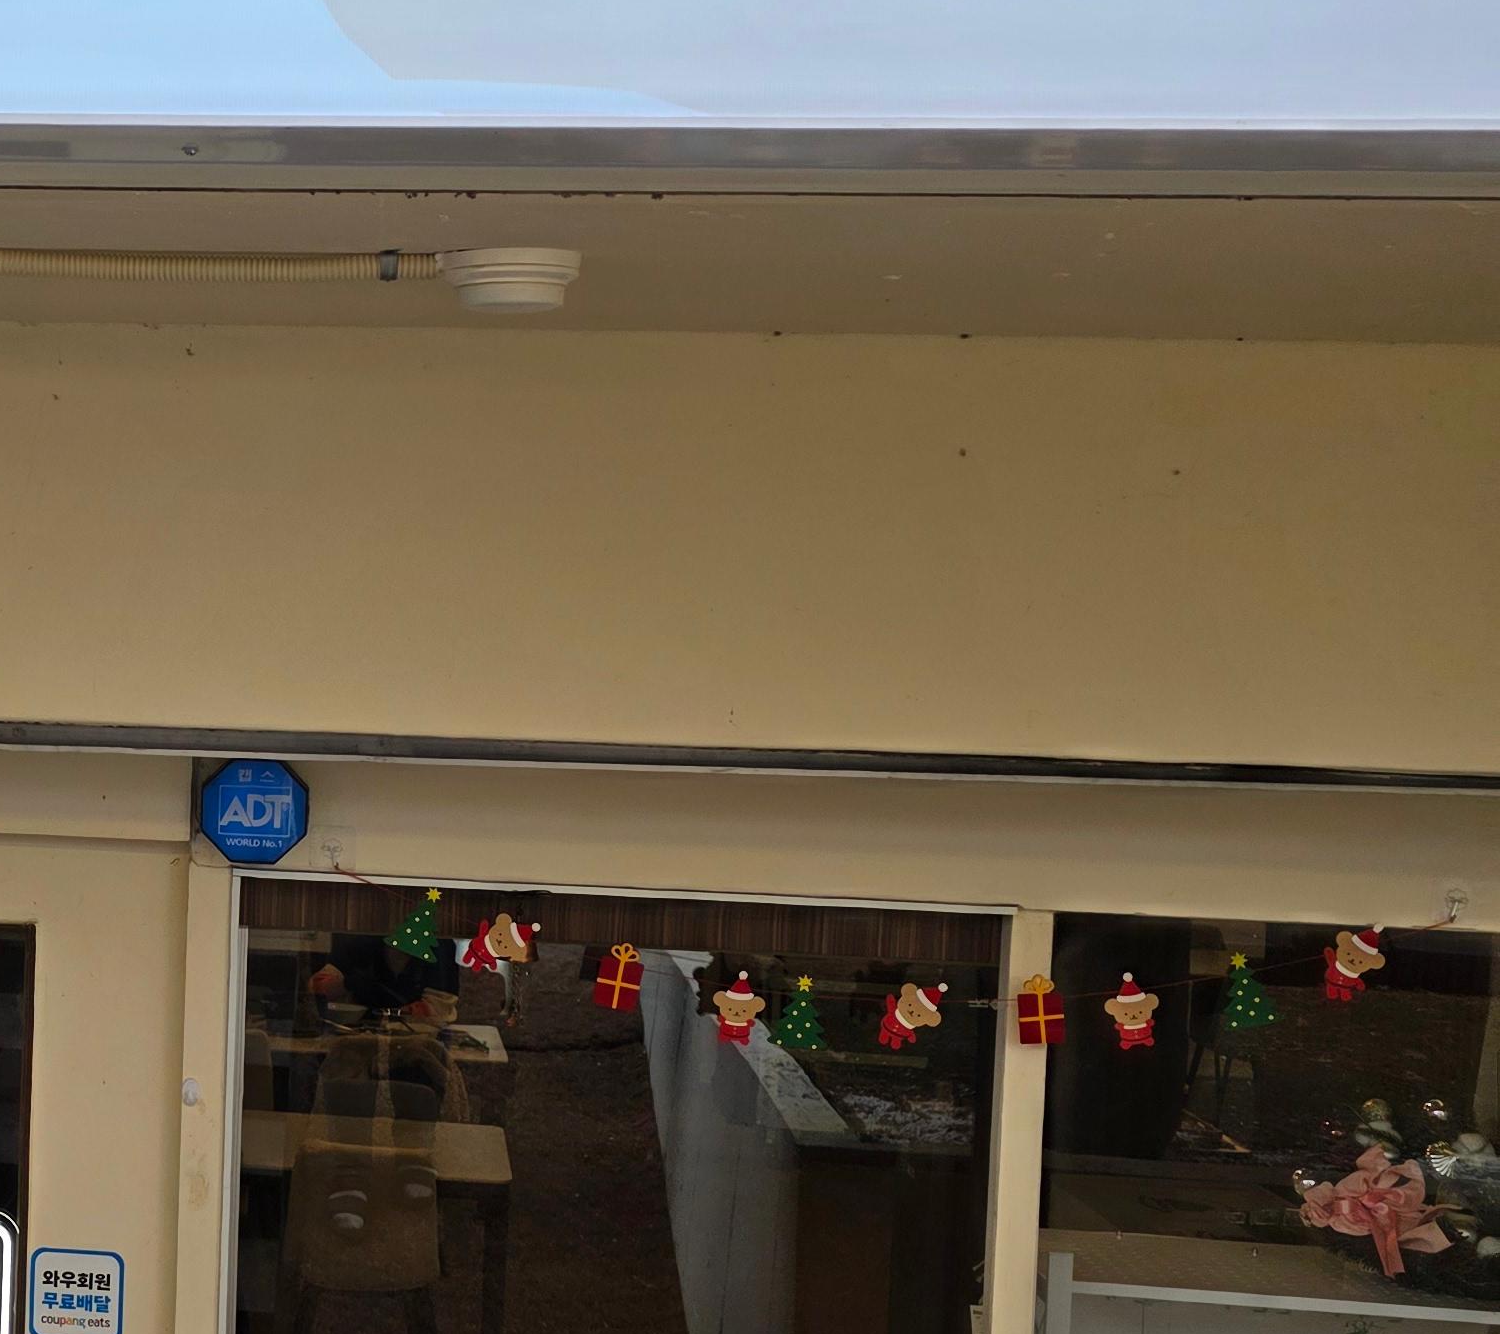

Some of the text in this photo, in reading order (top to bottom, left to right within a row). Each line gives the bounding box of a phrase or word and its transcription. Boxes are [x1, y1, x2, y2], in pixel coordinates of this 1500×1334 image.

[220, 794, 292, 829] ADT
[226, 838, 260, 847] WORLD
[42, 1270, 111, 1291] 와우회원
[41, 1292, 111, 1313] 무료배달
[41, 1315, 111, 1329] coupang eats
